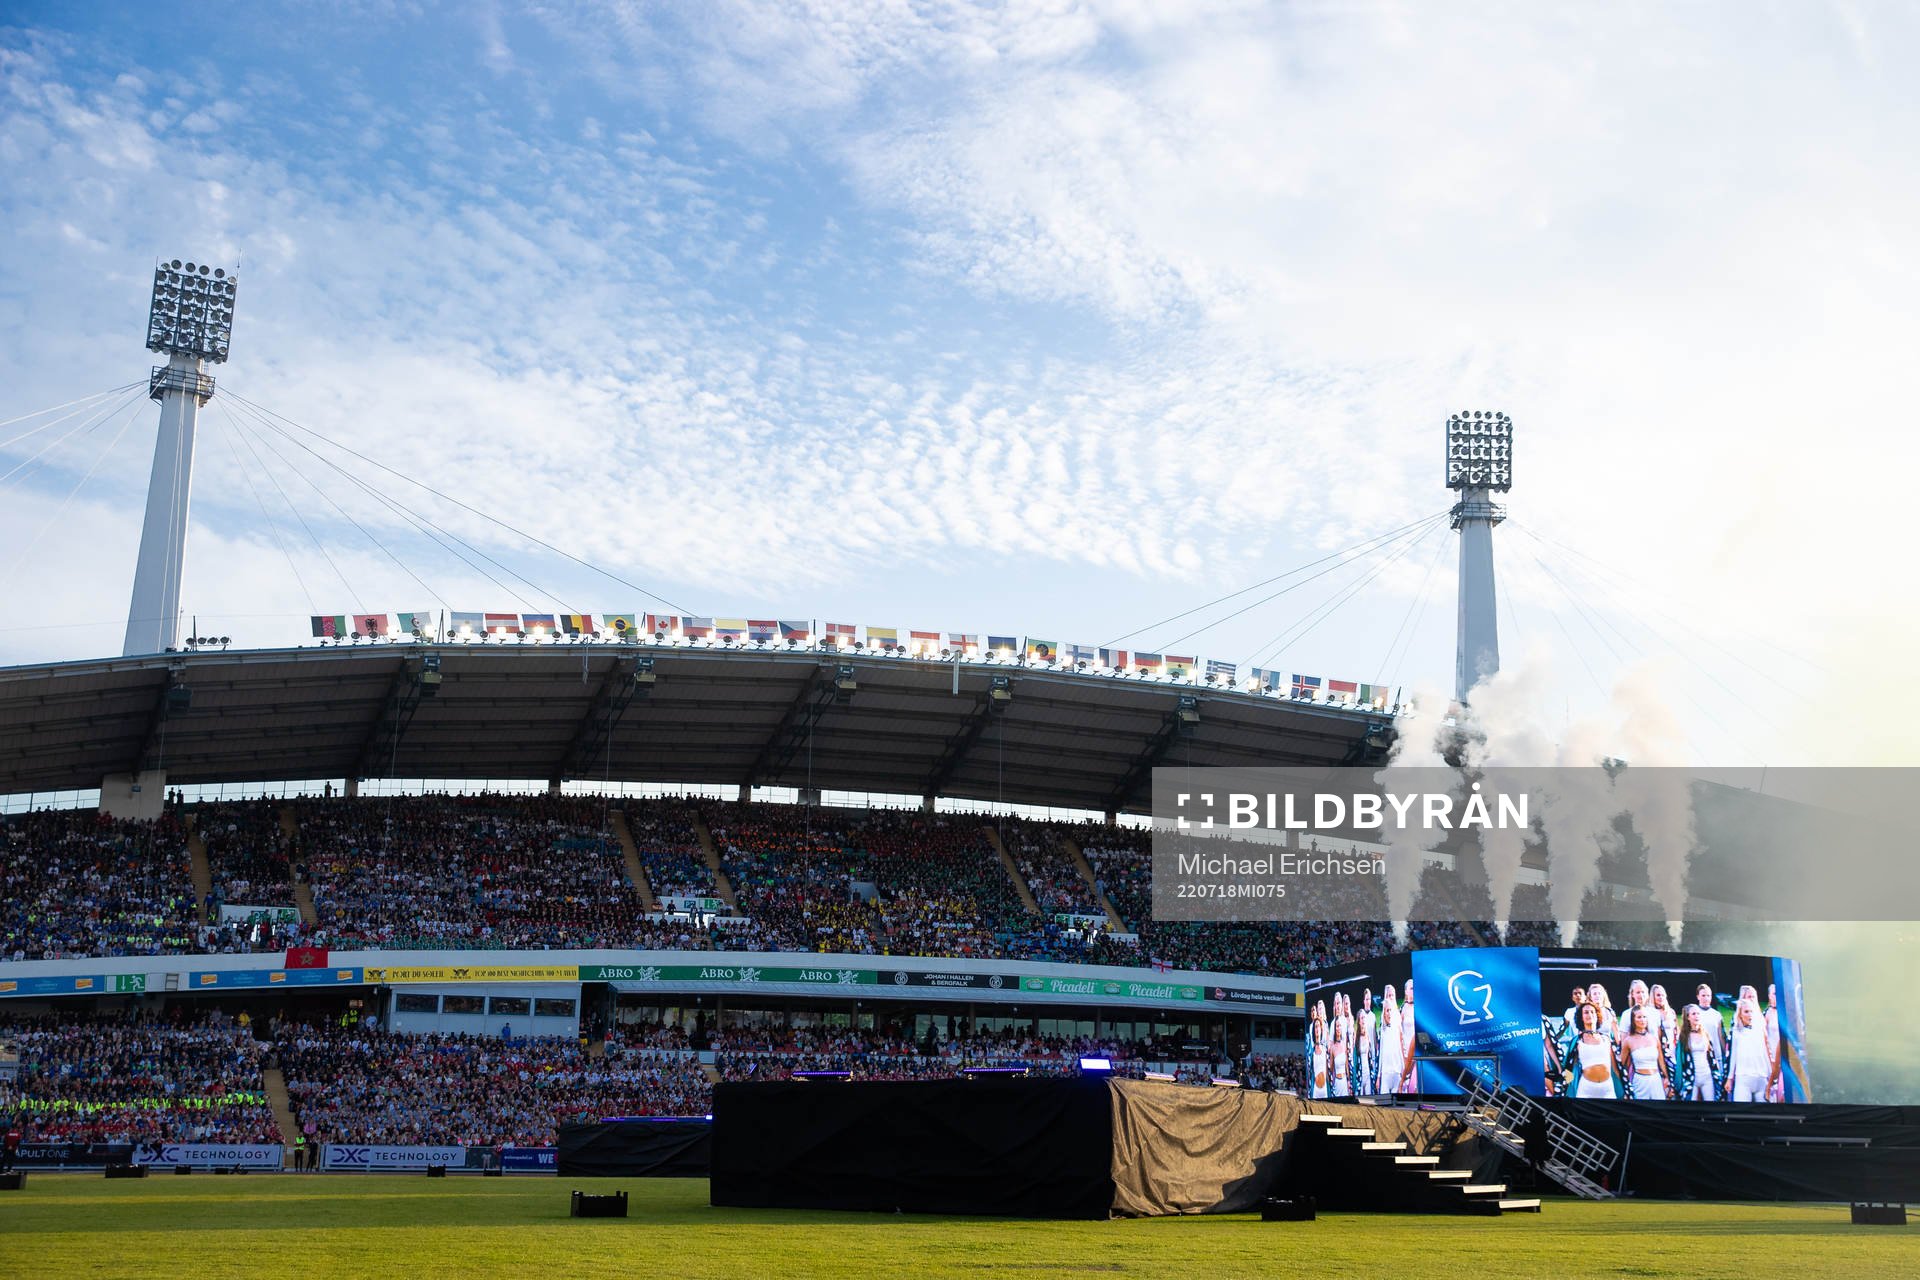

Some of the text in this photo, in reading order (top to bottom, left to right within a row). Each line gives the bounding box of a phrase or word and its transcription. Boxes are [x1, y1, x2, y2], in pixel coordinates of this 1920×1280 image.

[598, 967, 633, 978] ÅBRO
[699, 967, 734, 978] ÅBRO
[799, 969, 832, 981] ÅBRO
[1050, 979, 1095, 994] Picadeli
[1129, 983, 1173, 998] Picadeli
[1445, 1028, 1540, 1049] SPECIAL OLYMPICS TROPHY
[47, 1149, 70, 1158] ONE
[184, 1150, 270, 1159] TECHNOLOGY
[332, 1148, 457, 1163] DXC TECHNOLOGY
[538, 1153, 554, 1164] WE
